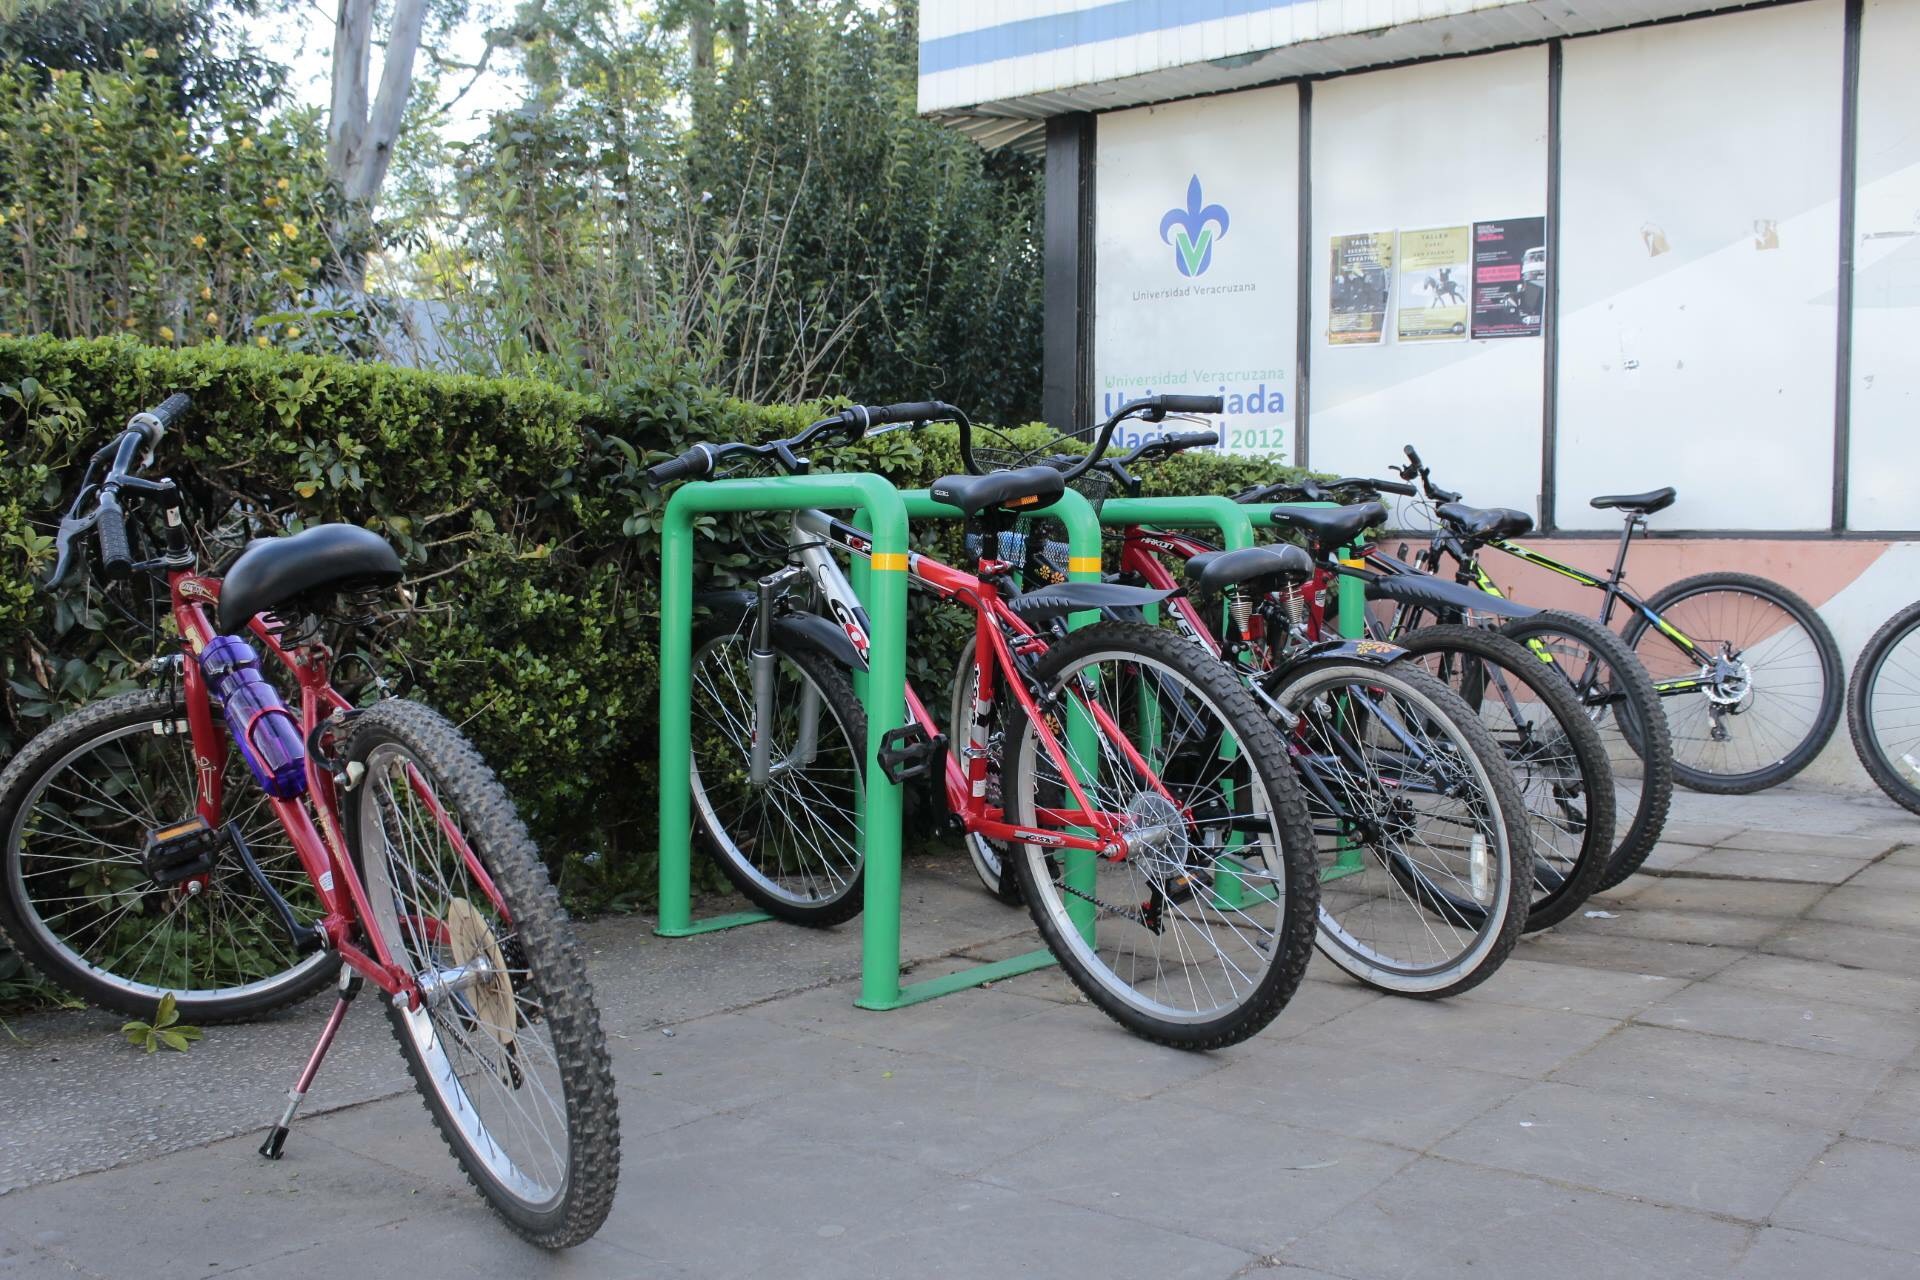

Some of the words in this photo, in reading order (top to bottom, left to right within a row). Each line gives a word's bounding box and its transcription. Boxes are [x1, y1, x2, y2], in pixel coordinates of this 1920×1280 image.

[1133, 287, 1190, 300] Universidad
[1193, 282, 1256, 296] Veracruzana
[1105, 370, 1187, 388] Universidad
[1193, 369, 1284, 382] Veracruzana
[1231, 429, 1285, 449] 2012
